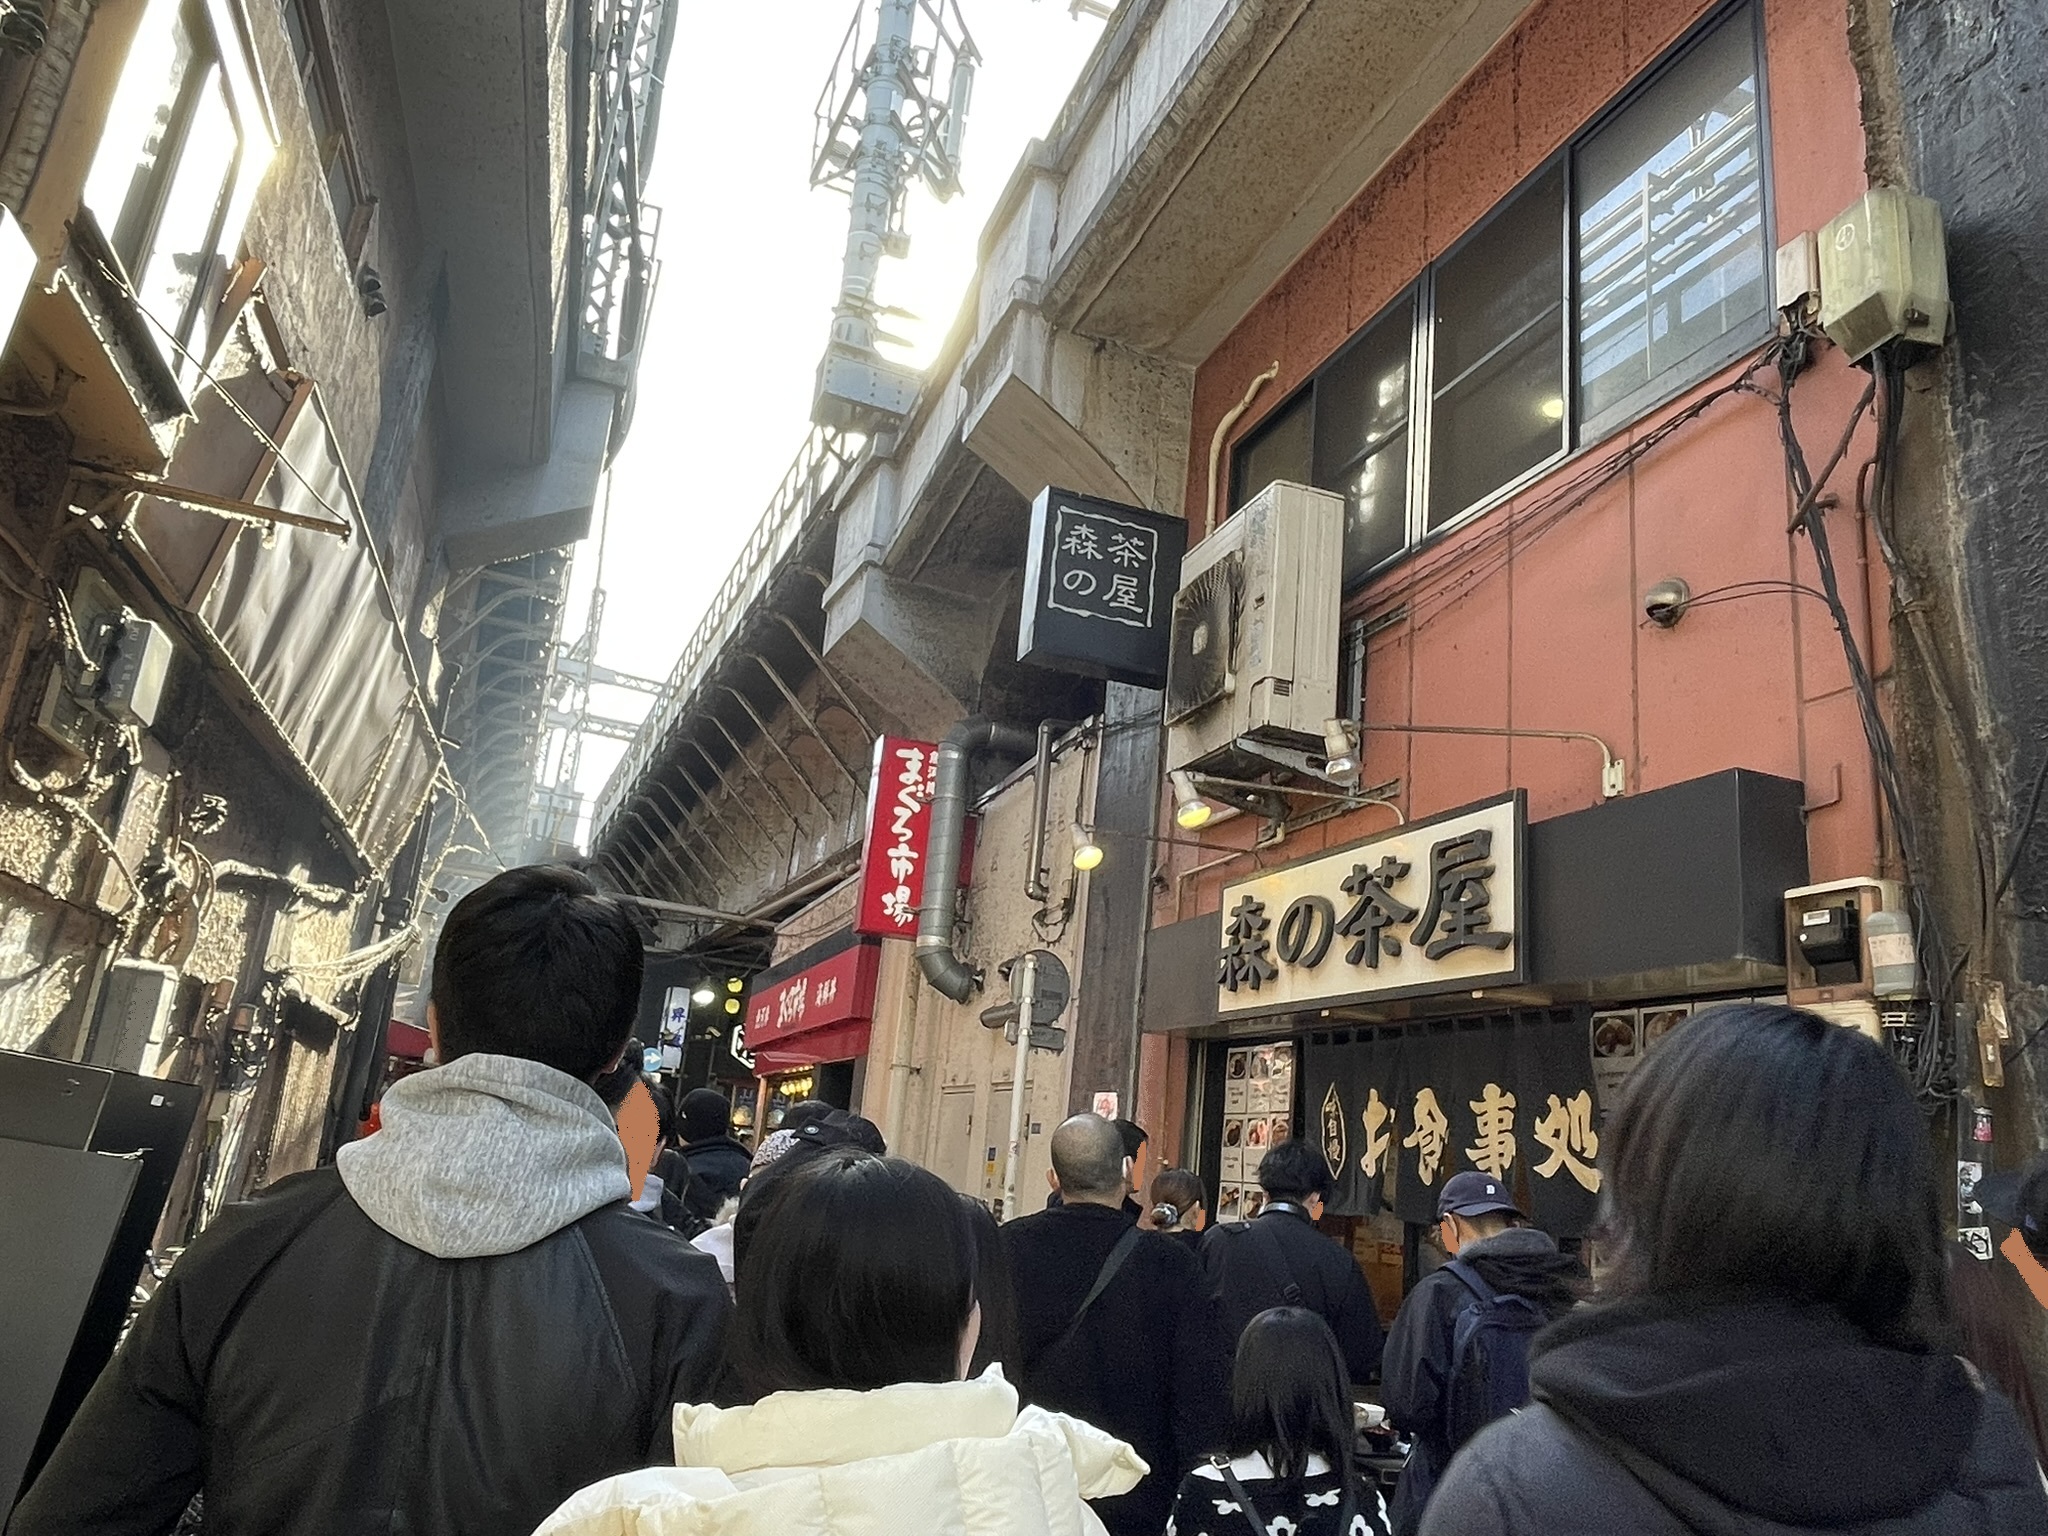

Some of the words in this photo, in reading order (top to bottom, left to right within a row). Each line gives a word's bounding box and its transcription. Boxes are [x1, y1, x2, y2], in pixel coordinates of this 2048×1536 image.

[881, 747, 924, 928] まぐろ市場
[1217, 829, 1513, 992] 森の茶屋
[1360, 1083, 1603, 1194] お食事処
